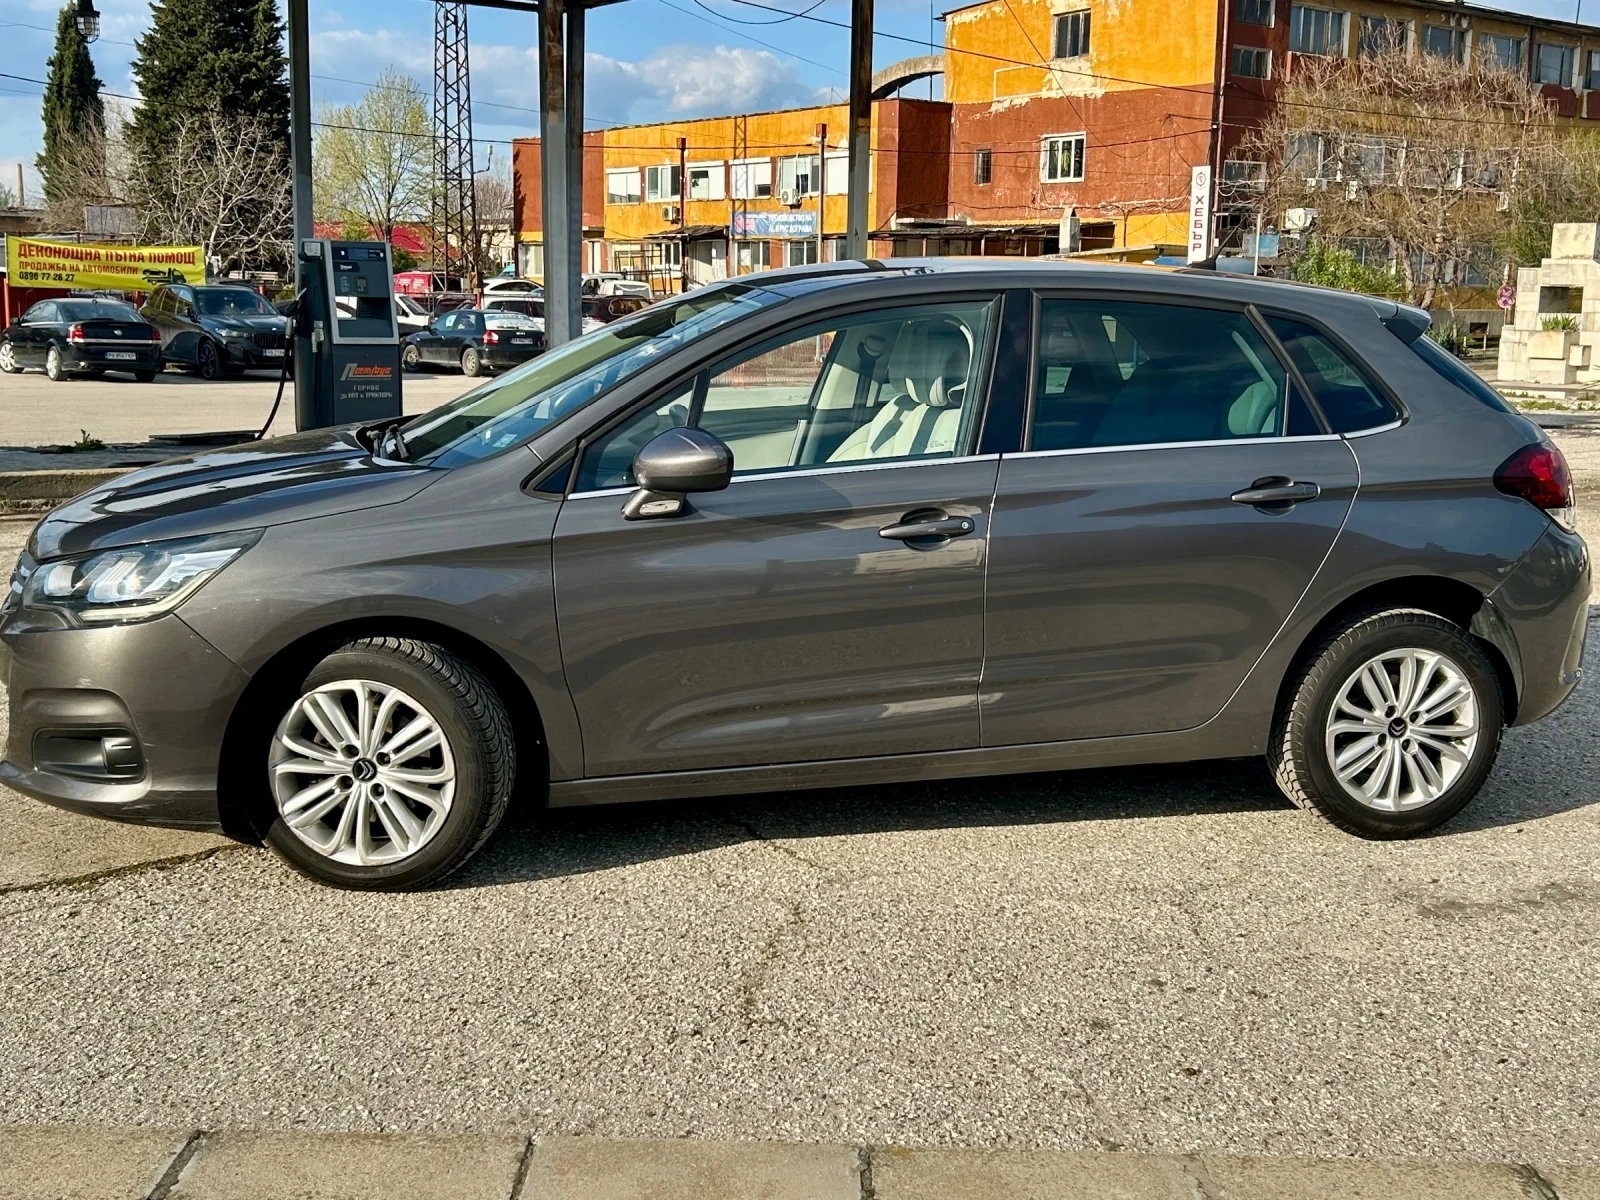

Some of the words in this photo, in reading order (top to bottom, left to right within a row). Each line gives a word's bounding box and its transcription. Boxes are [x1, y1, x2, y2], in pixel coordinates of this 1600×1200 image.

[1192, 195, 1205, 252] ХЕБЪР
[18, 243, 101, 261] ДЕНОНОЩНА
[105, 250, 145, 263] ПЪТНА
[148, 252, 195, 265] ПОМОЩ
[19, 262, 67, 272] ПРОДАЖБА
[69, 264, 80, 273] НА
[82, 265, 138, 274] АВТОМОБИЛИ
[41, 272, 51, 281] 77
[65, 273, 75, 282] 27
